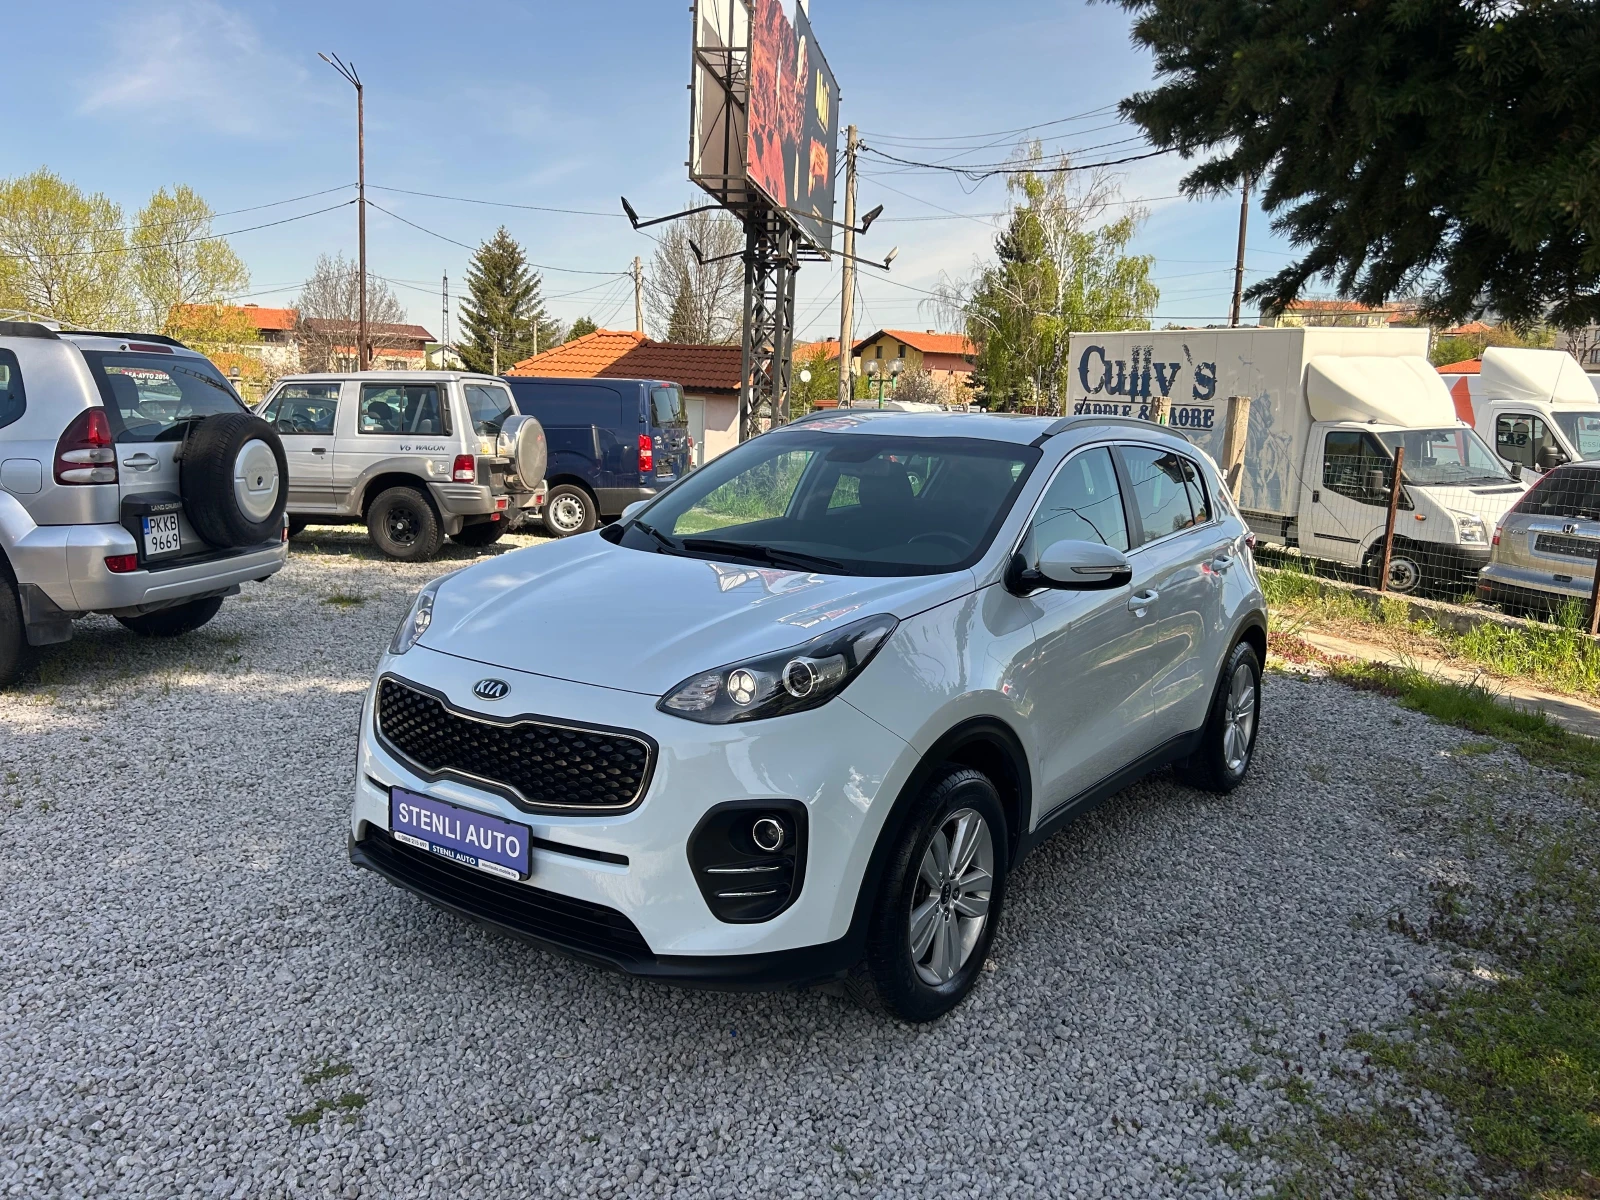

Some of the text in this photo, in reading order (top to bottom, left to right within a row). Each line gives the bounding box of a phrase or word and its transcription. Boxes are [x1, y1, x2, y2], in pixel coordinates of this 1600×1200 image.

[149, 517, 177, 534] PKKB
[152, 534, 177, 551] 9669
[475, 680, 504, 697] KIA
[399, 803, 520, 858] STENLI AUTO
[433, 845, 476, 865] STENLI AUTO
